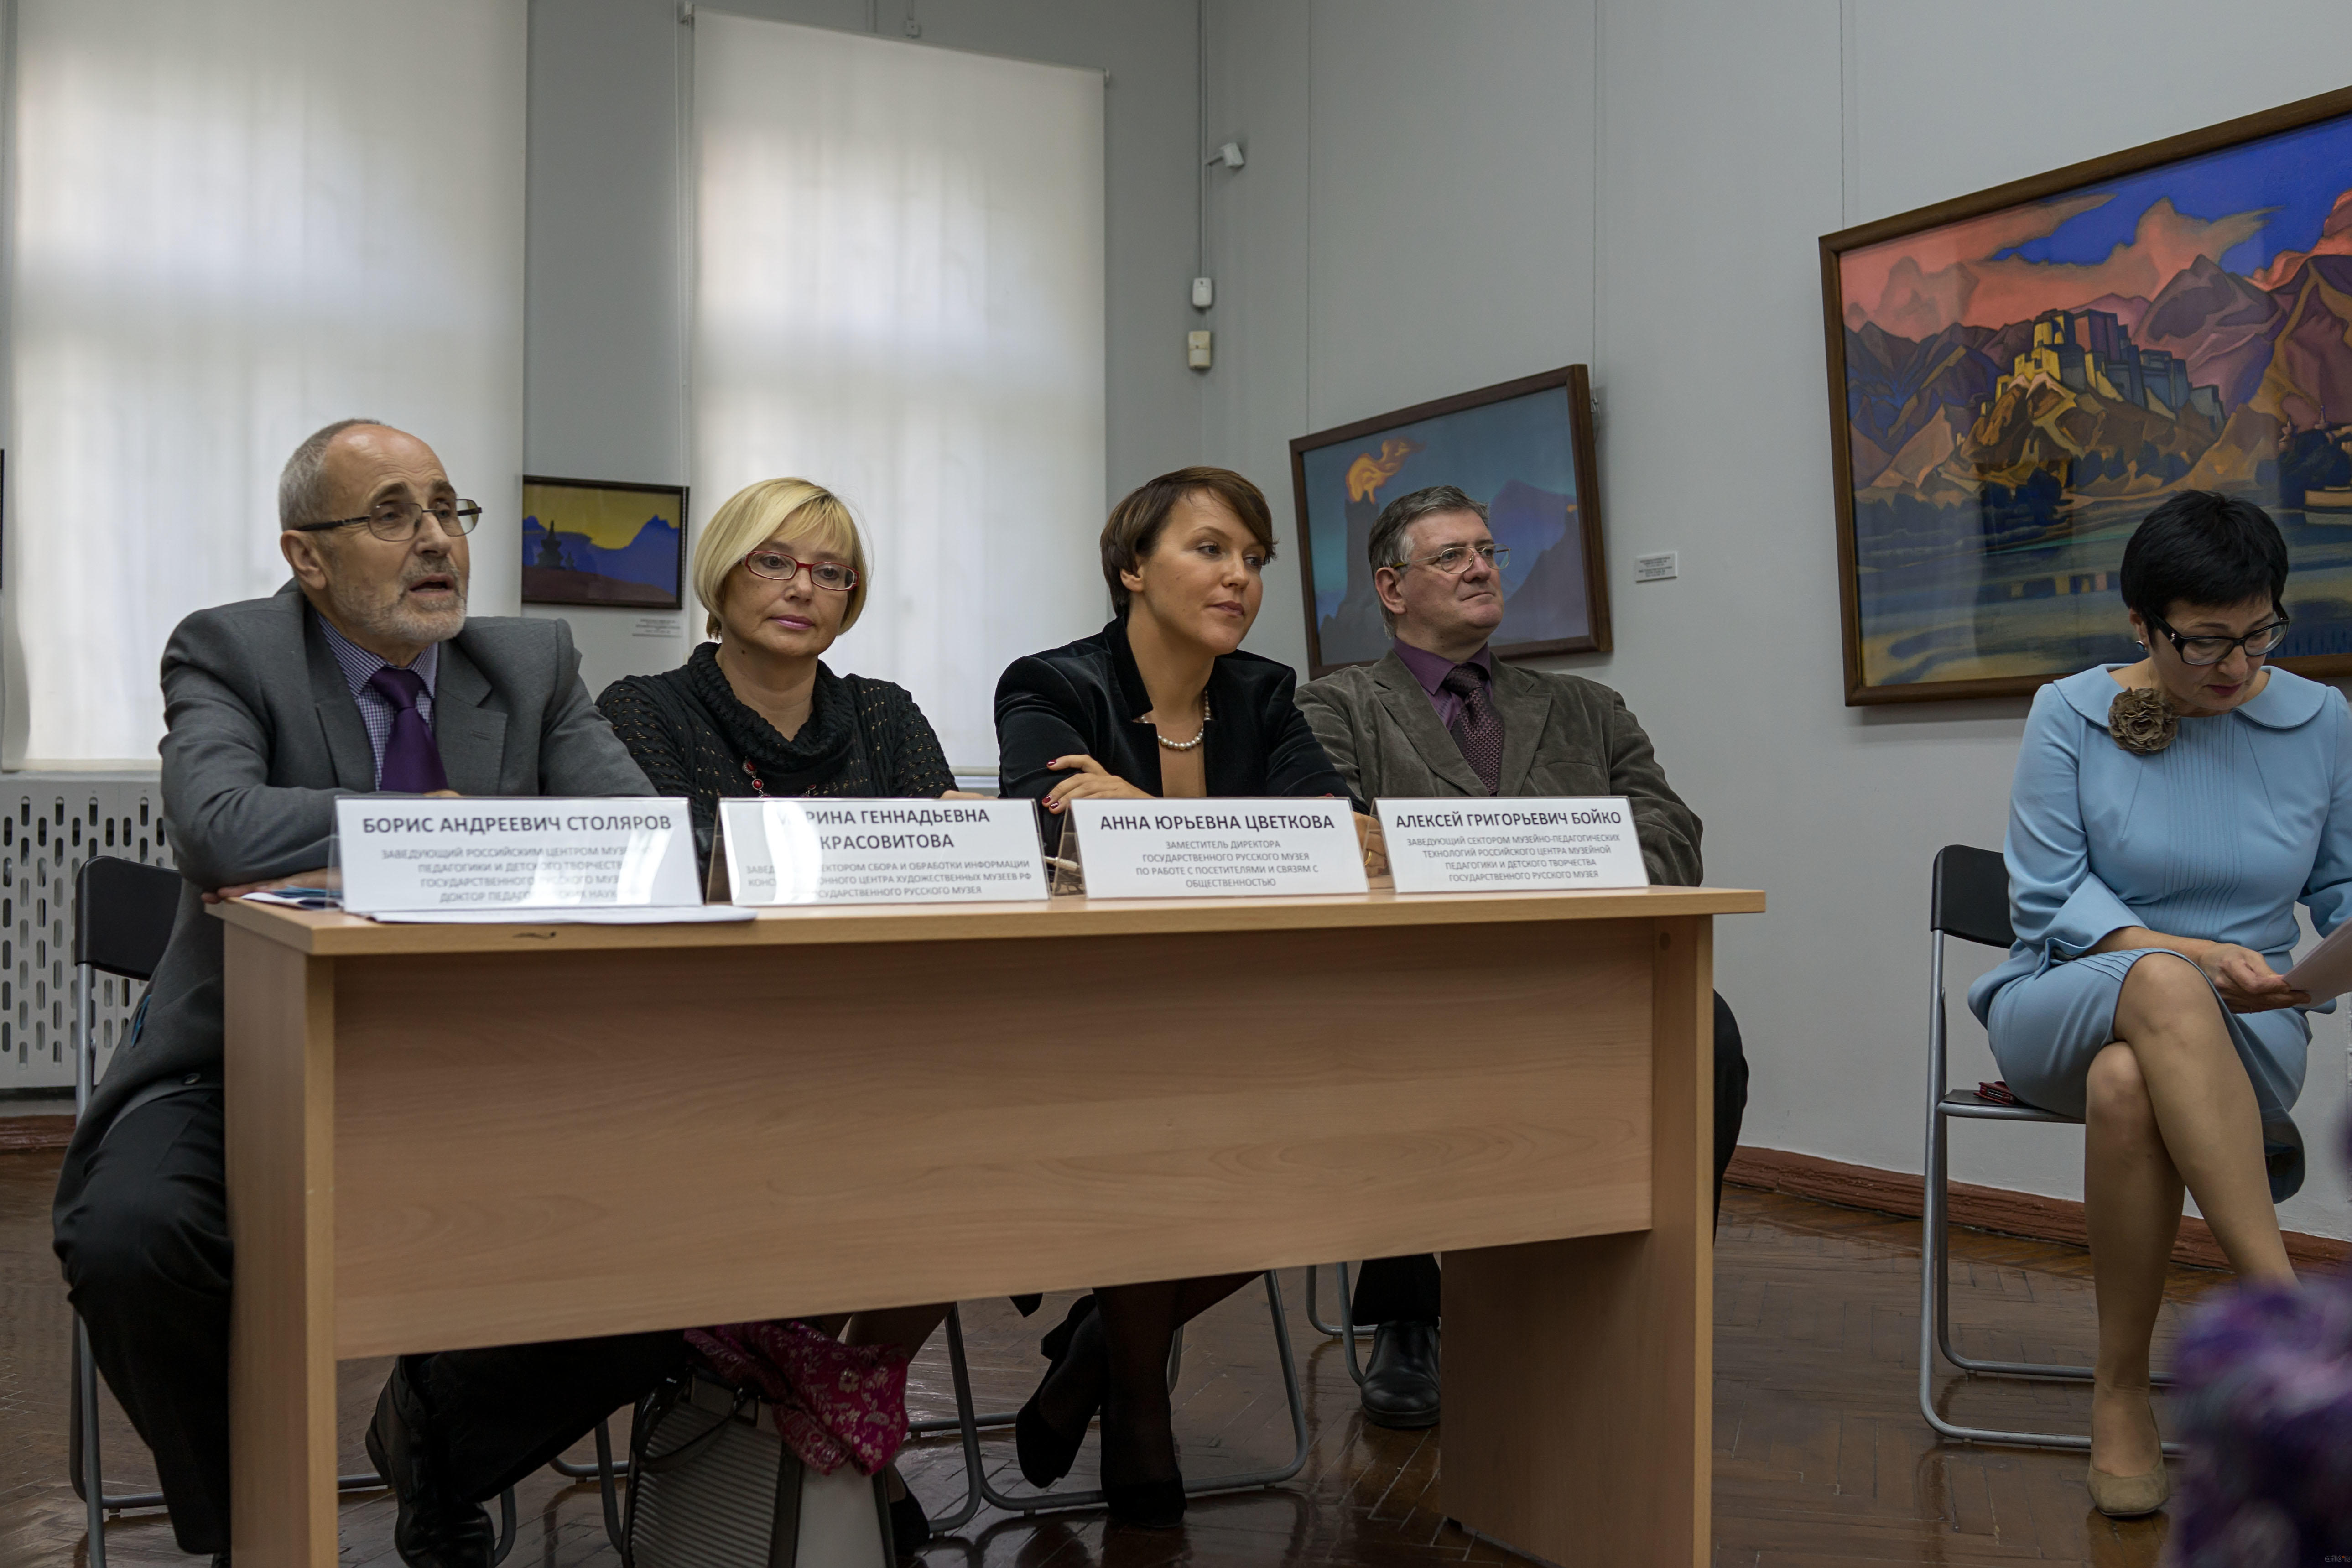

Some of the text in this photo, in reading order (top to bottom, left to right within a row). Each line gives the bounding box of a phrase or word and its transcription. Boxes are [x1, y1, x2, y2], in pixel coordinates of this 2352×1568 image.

[861, 809, 990, 826] ГЕННАДЬЕВНА
[1101, 815, 1335, 832] АННА ЮРЬЕВНА ЦВЕТКОВА
[1396, 809, 1621, 828] АЛЕКСЕЙ ГРИГОРЬЕВИЧ БОЙКО
[363, 815, 671, 835] БОРИС АНДРЕЕВИЧ СТОЛЯРОВ
[820, 834, 954, 849] КРАСОВИТОВА
[1166, 840, 1281, 850] ЗАМЕСТИТЕЛЬ ДИРЕКТОРА
[1407, 834, 1621, 847] ЗАВЕДУЮЩИЙ СЕКТОРОМ МУЗЕЙНО-ПЕДАГОГИЧЕСКИХ
[381, 847, 464, 860] ЗАВЕДУЮЩИЙ
[466, 846, 543, 858] РОССИЙСКИМ
[546, 847, 599, 858] ЦЕНТРОМ
[1422, 844, 1612, 858] ТЕХНОЛОГИЙ РОССИЙСКОГО ЦЕНТРА МУЗЕЙНОЙ
[1142, 852, 1310, 864] ГОСУДАРСТВЕННОГО РУССКОГО МУЗЕЯ
[1445, 861, 1498, 870] ПЕДАГОГИКИ
[1507, 860, 1547, 869] ДЕТСКОГО
[1548, 859, 1597, 867] ТВОРЧЕСТВА
[418, 863, 492, 874] ПЕДАГОГИКИ
[494, 863, 503, 872] И
[563, 860, 626, 870] ТВОРЧЕСТВ
[819, 863, 866, 872] ЕКТОРОМ
[867, 863, 898, 871] СБОРА
[908, 861, 963, 870] ОБРАБОТКИ
[964, 860, 1030, 869] ИНФОРМАЦИИ
[1135, 867, 1150, 875] ПО
[1151, 867, 1185, 875] РАБОТЕ
[1187, 867, 1193, 875] С
[1195, 865, 1266, 875] ПОСЕТИТЕЛЯМИ
[1276, 865, 1311, 874] СВЯЗЯМ
[1312, 865, 1319, 873] С
[420, 875, 534, 888] ГОСУДАРСТВЕННОГО
[540, 875, 593, 885] ССКОГО
[859, 875, 895, 885] ЦЕНТРА
[896, 874, 981, 884] ХУДОЖЕСТВЕННЫХ
[983, 872, 1018, 881] МУЗЕЕВ
[1448, 870, 1599, 882] ГОСУДАРСТВЕННОГО РУССКОГО МУЗЕЯ
[1186, 878, 1276, 888] ОБЩЕСТВЕННОСТЬЮ
[439, 892, 487, 903] ДОКТОР
[810, 886, 982, 899] СУДАРСТВЕННОГО РУССКОГО МУЗЕЯ
